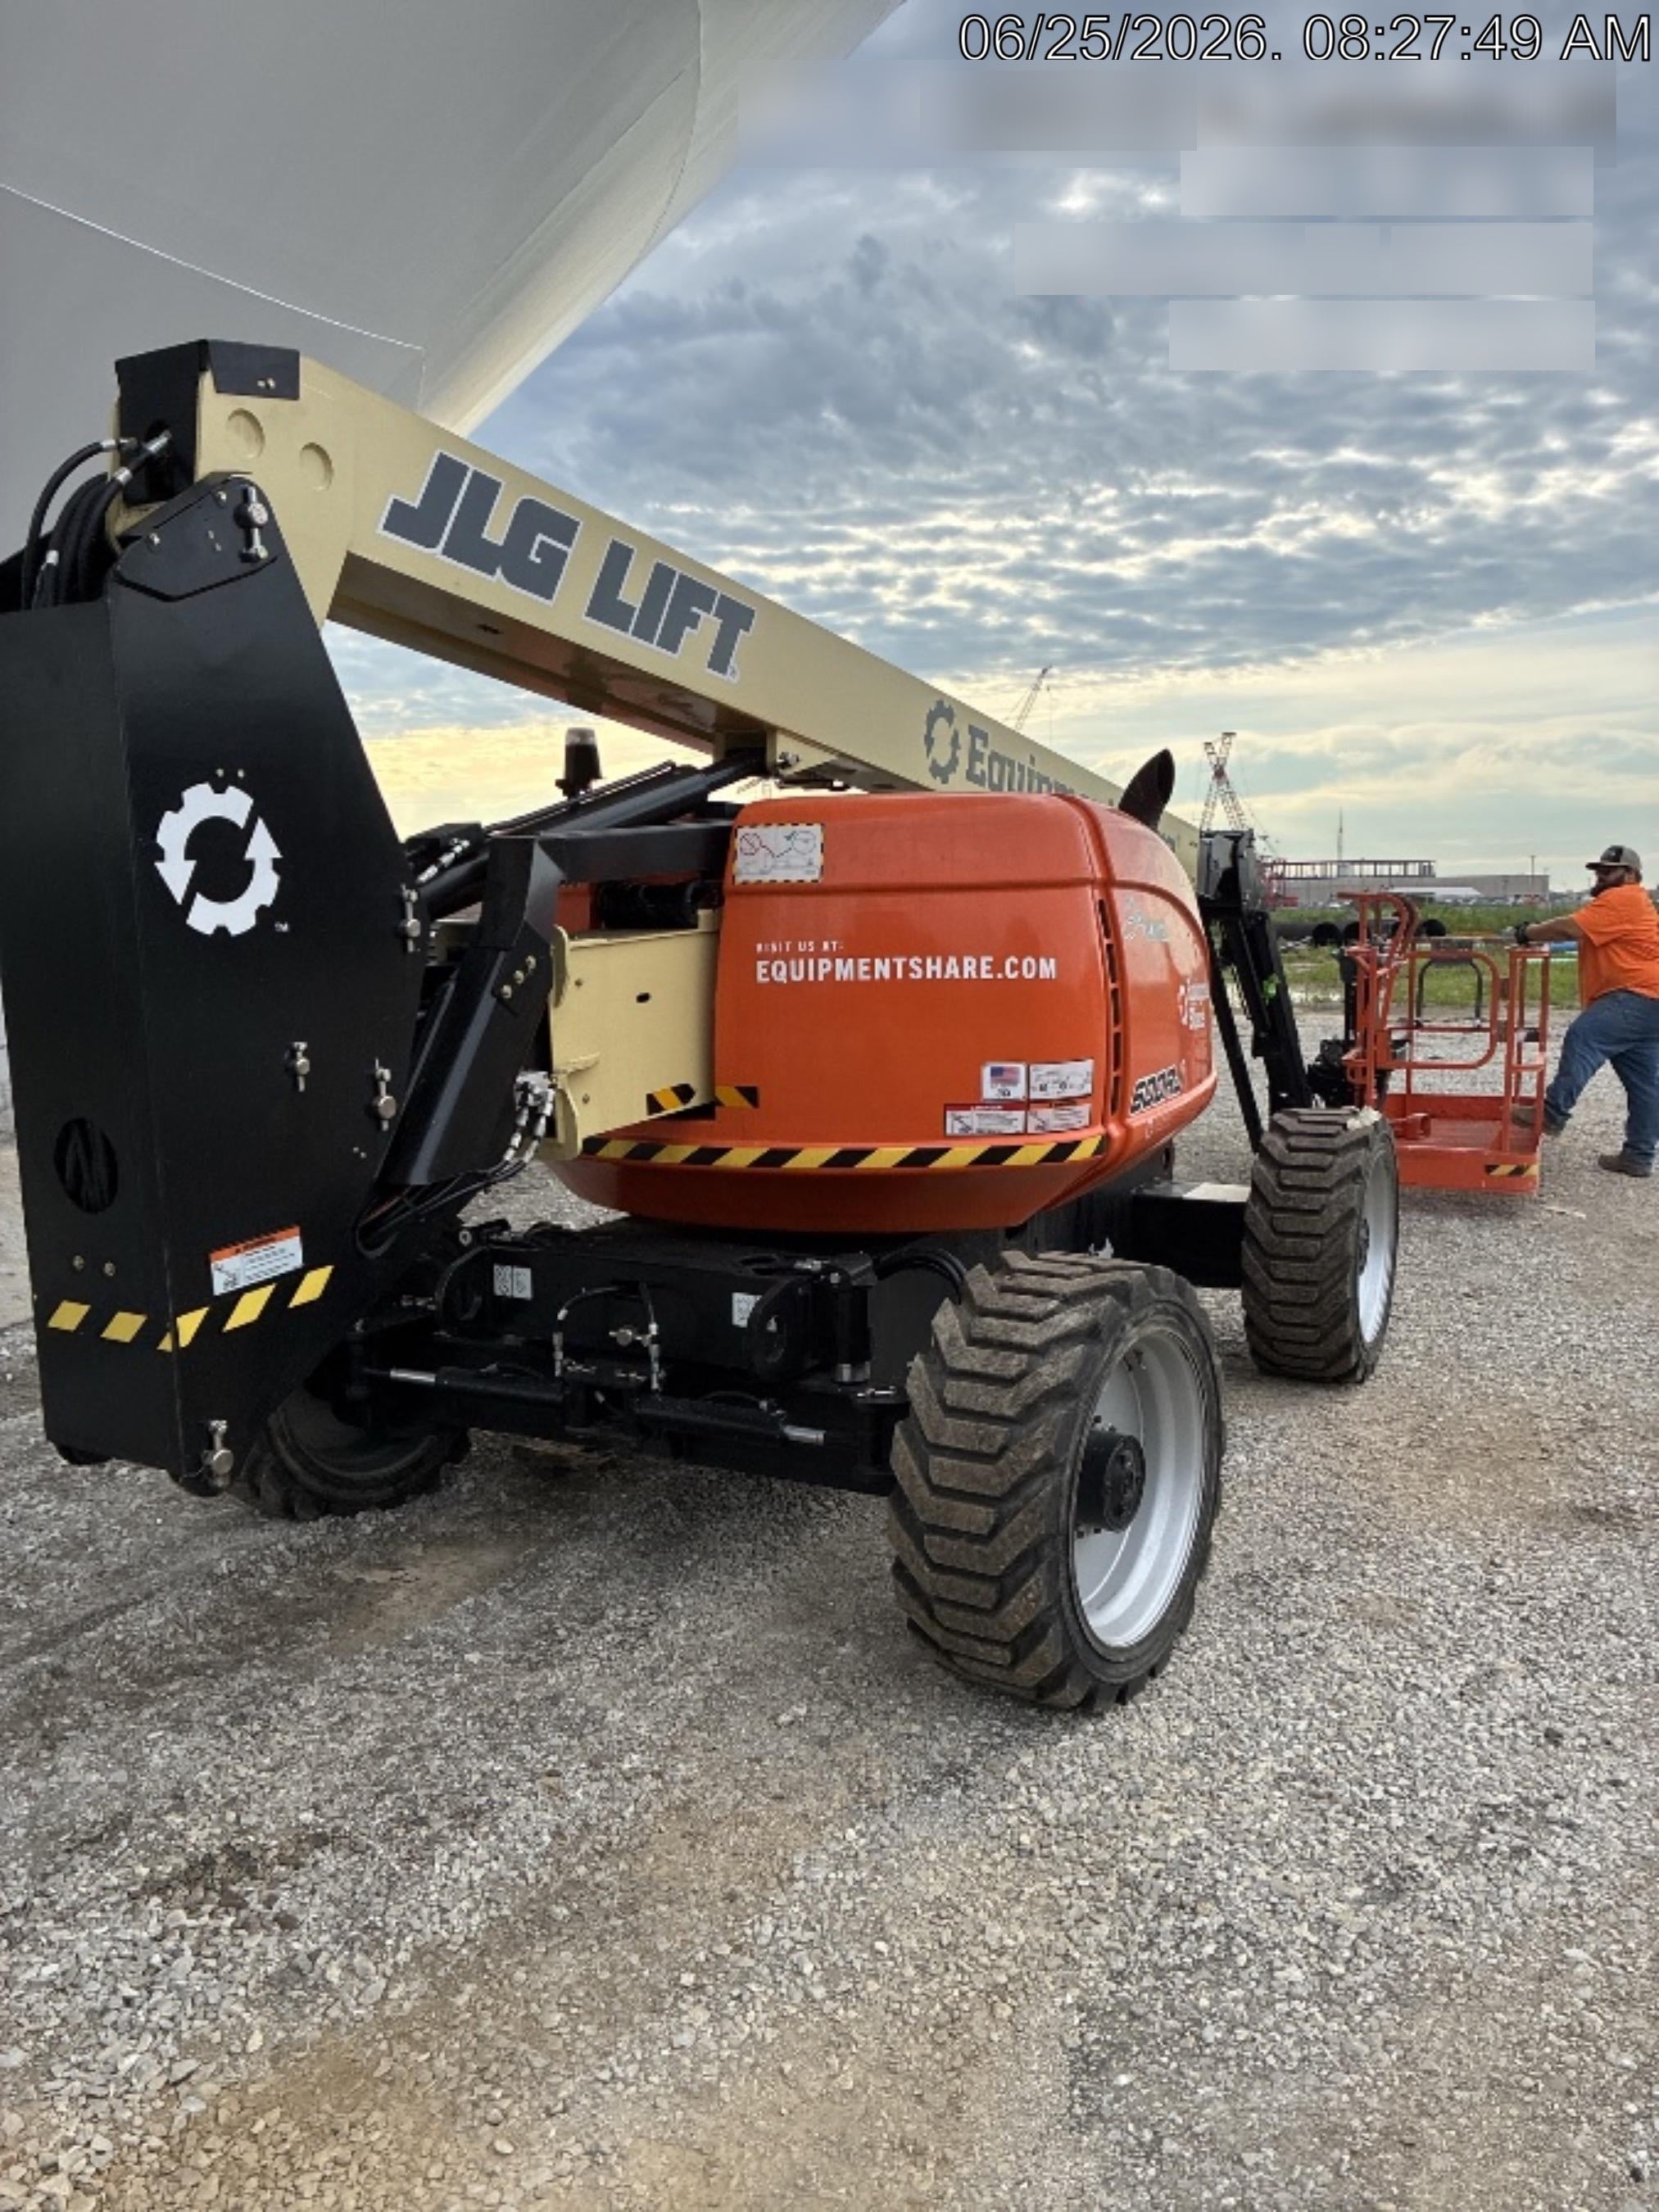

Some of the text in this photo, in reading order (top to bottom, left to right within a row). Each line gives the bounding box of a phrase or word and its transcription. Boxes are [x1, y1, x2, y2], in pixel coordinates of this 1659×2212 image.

[378, 450, 756, 682] JLG LIFT
[798, 941, 815, 952] US
[755, 955, 1057, 984] EQUIPMENTSHARE.COM
